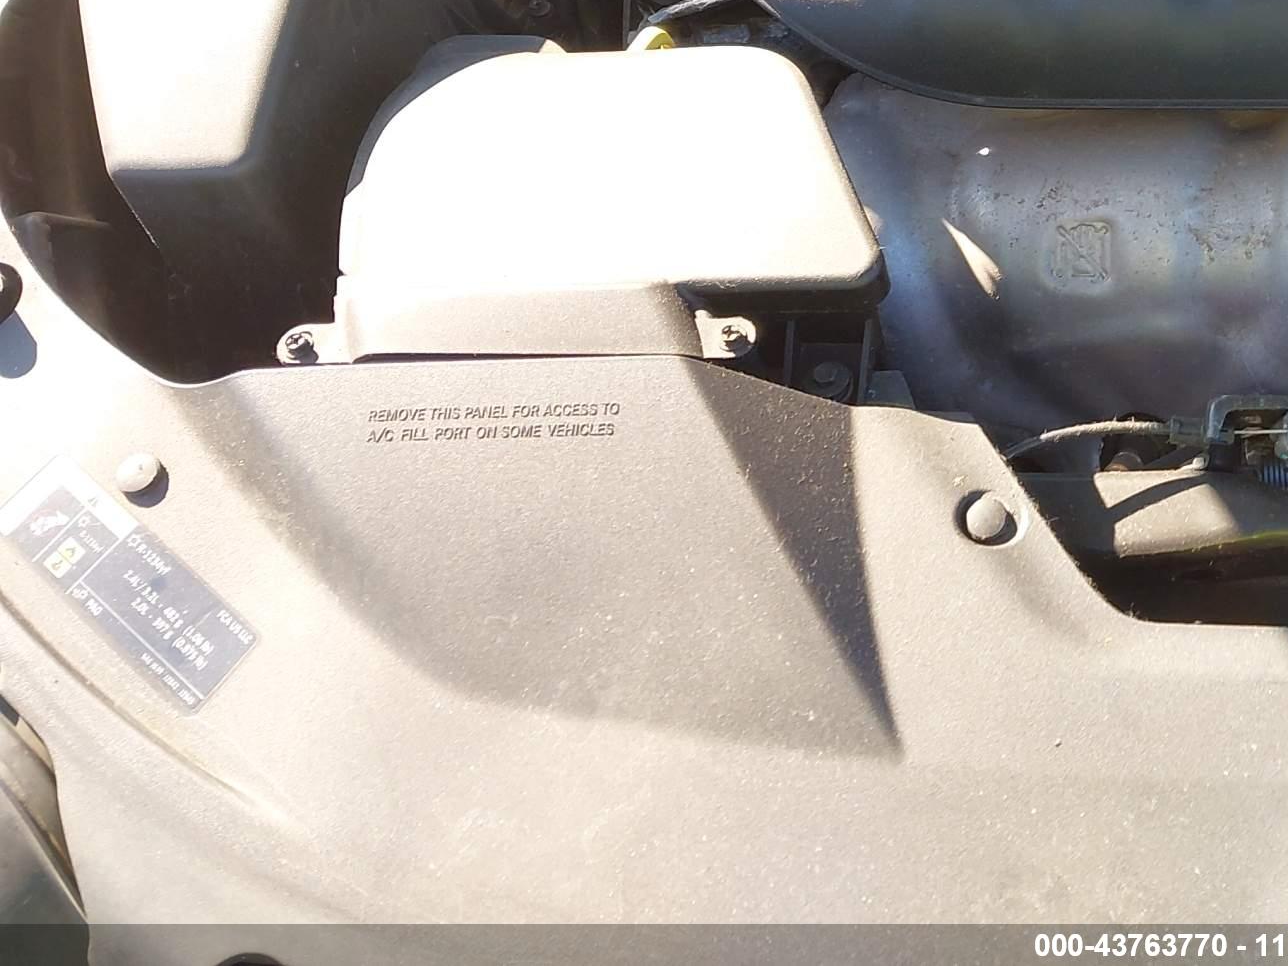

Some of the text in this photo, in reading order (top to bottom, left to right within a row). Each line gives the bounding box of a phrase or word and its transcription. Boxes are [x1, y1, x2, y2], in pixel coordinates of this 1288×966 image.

[368, 402, 621, 422] REMOVE THIS PANEL FOR ACCESS TO
[366, 423, 616, 443] A/C FILL PORT ON SOME VEHICLES
